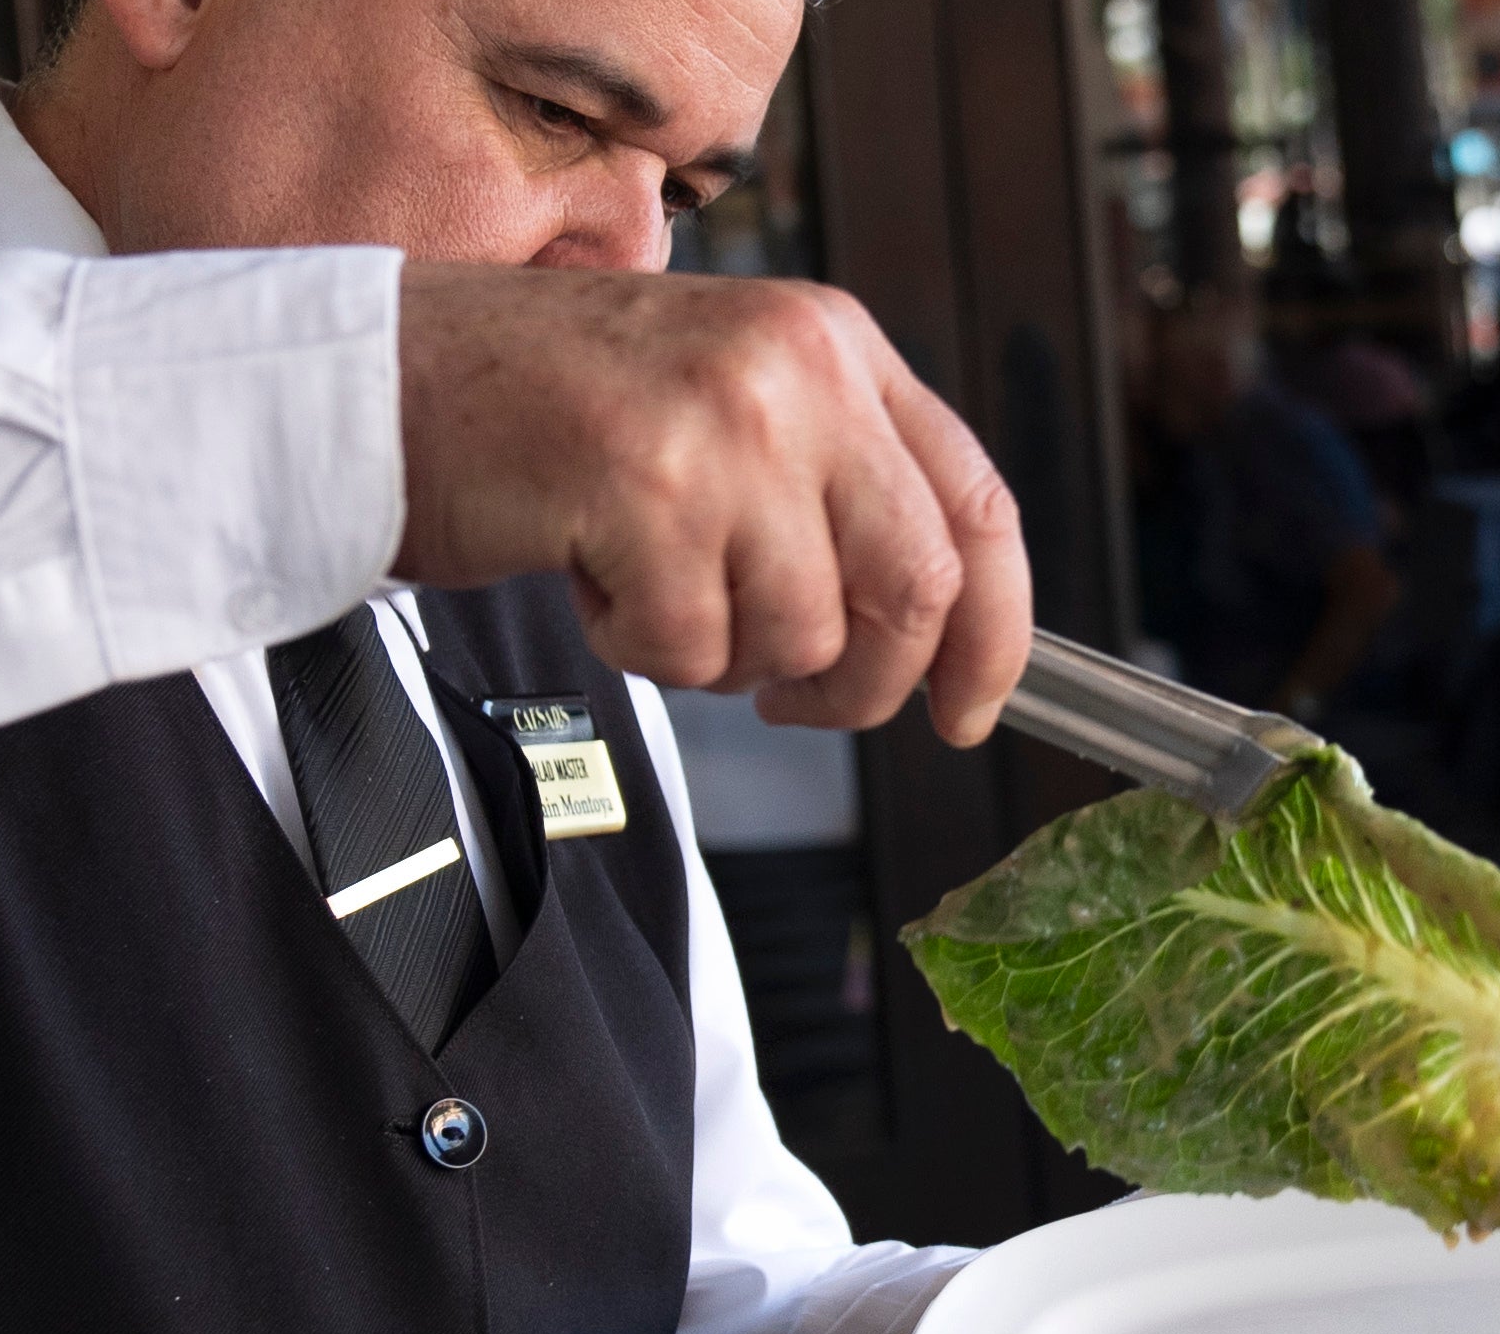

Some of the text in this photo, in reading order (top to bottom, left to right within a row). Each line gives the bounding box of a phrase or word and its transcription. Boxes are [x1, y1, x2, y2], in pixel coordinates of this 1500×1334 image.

[531, 757, 589, 783] ALAD MASTER
[541, 793, 614, 819] ain Montoya
